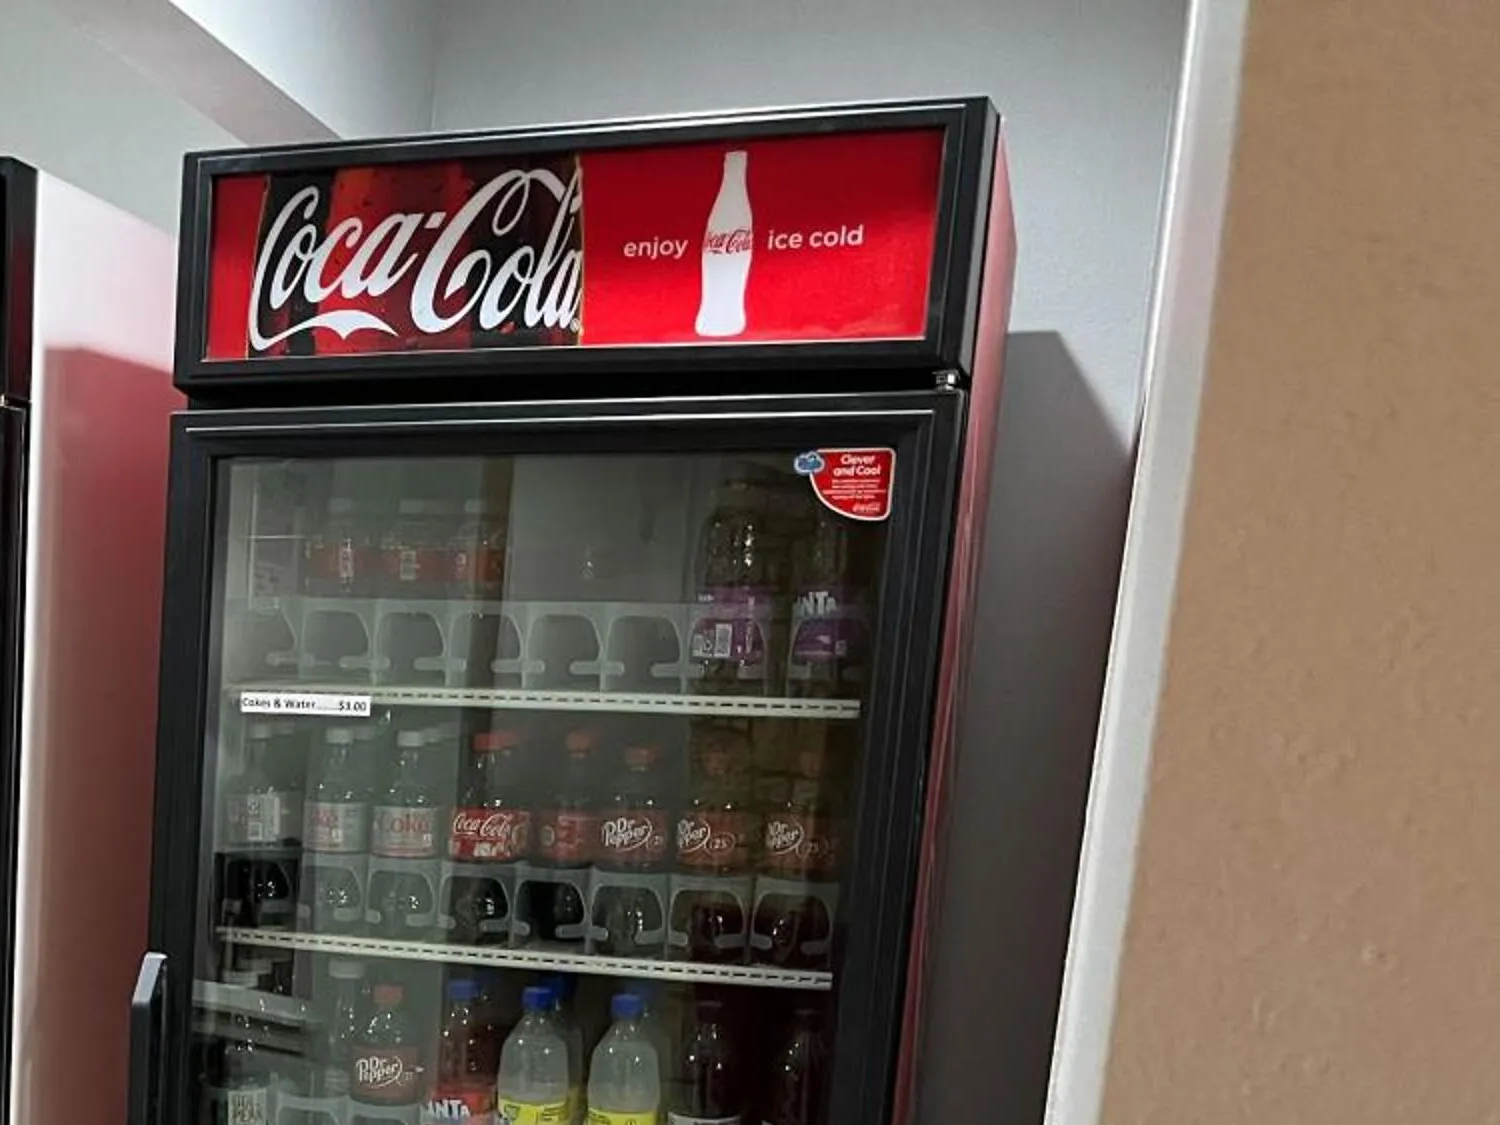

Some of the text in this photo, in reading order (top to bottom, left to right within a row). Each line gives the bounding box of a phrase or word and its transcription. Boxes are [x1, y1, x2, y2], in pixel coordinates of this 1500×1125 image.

[623, 236, 689, 260] enjoy
[767, 224, 864, 250] ice cold
[249, 168, 583, 351] Coca-Cola
[856, 464, 881, 476] Cool
[453, 812, 513, 838] Coca-Cola
